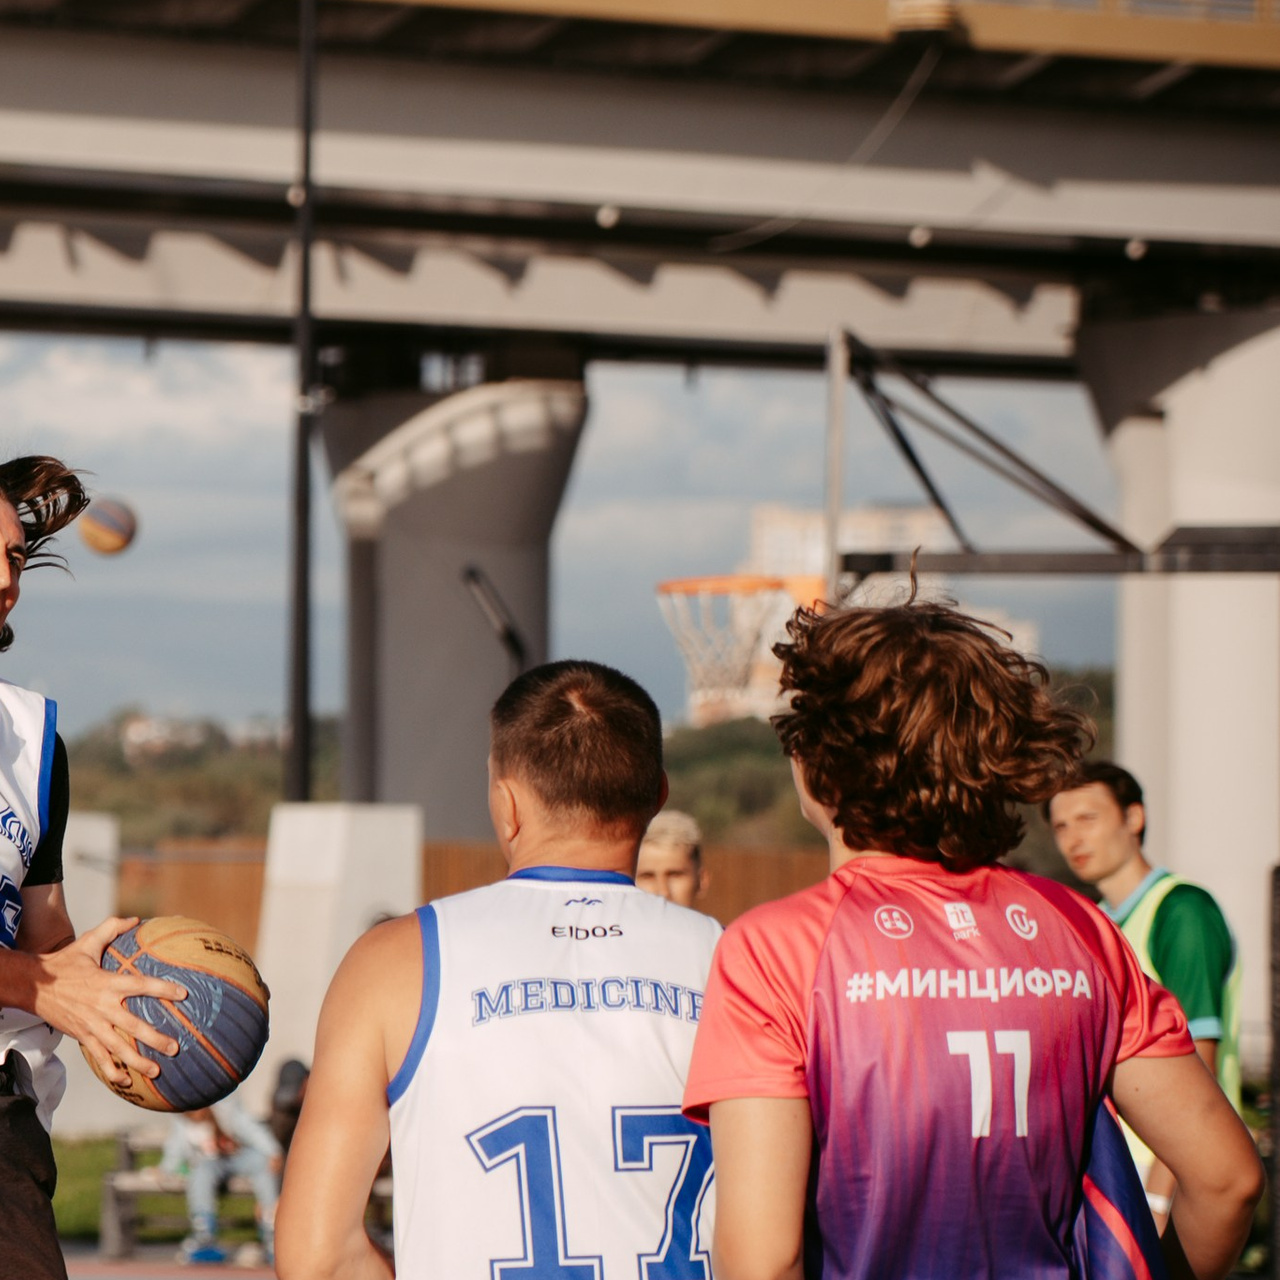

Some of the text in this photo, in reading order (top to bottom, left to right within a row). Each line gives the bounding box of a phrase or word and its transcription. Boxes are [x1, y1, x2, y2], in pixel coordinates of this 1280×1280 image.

[551, 924, 624, 941] EIDOS
[953, 926, 980, 942] park
[846, 967, 1092, 1003] #МИНЦИФРА
[946, 1030, 1031, 1138] 11
